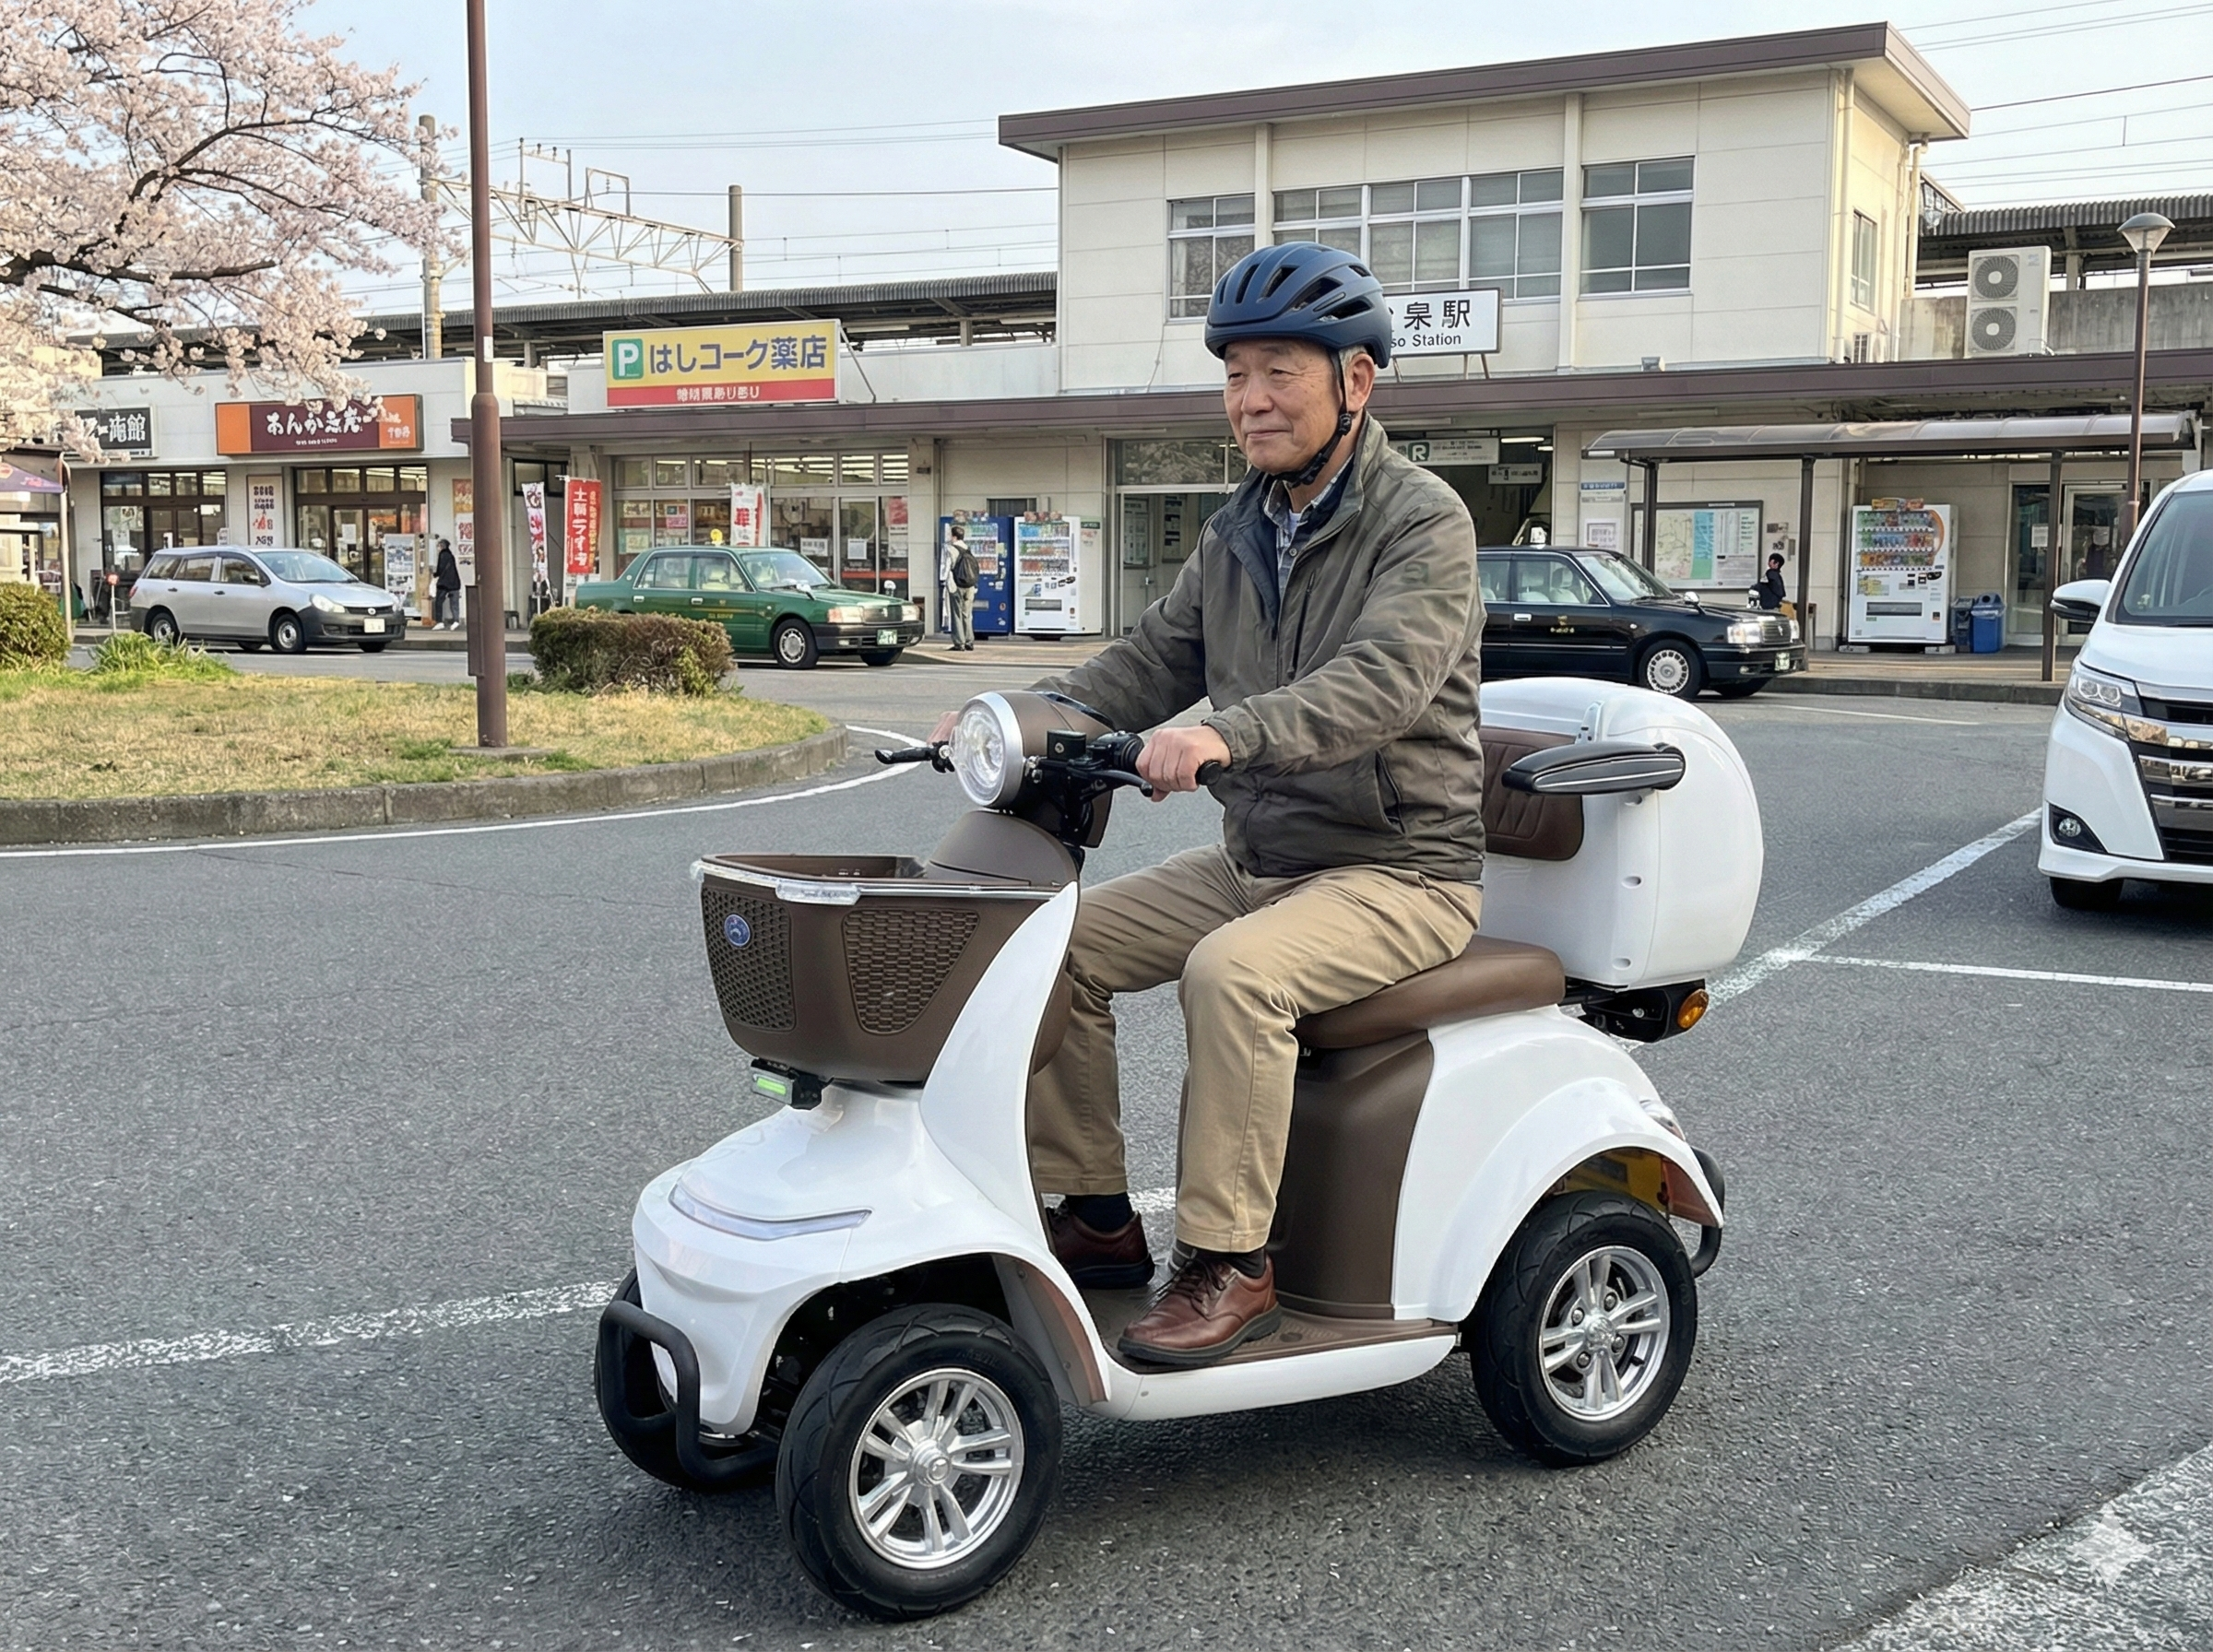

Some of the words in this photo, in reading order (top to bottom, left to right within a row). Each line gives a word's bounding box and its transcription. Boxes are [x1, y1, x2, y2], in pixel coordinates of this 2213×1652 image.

[1413, 333, 1462, 347] Station
[618, 343, 639, 377] P
[650, 335, 827, 373] はしコーク薬店
[1412, 444, 1426, 461] R
